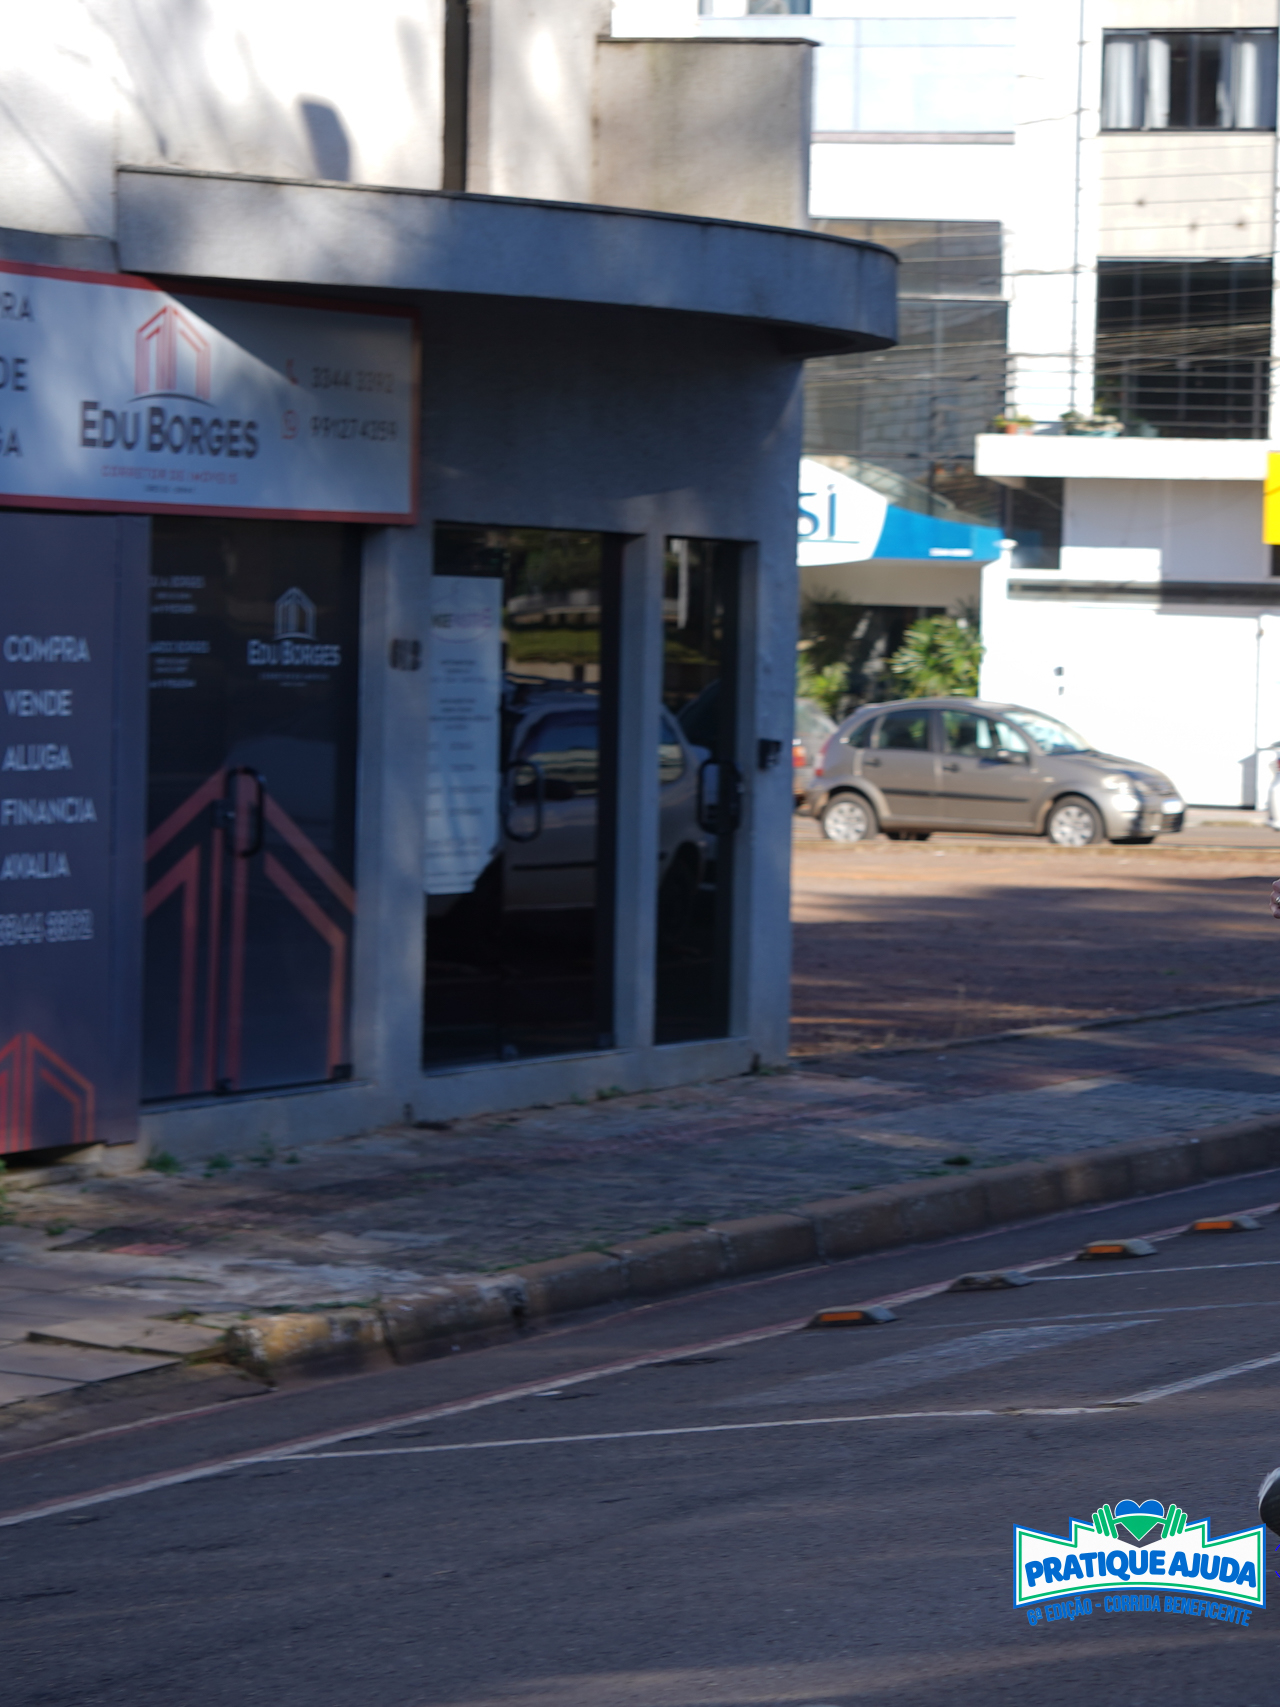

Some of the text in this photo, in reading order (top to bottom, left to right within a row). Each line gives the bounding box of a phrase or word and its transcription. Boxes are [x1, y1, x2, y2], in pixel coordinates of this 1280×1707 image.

[80, 401, 260, 460] EDU BORGES
[3, 636, 90, 662] COMPRA
[4, 690, 73, 716] VENDE
[3, 744, 73, 771] ALUGA
[1, 797, 97, 825] FINANCIA
[1, 852, 70, 879] AVALIA
